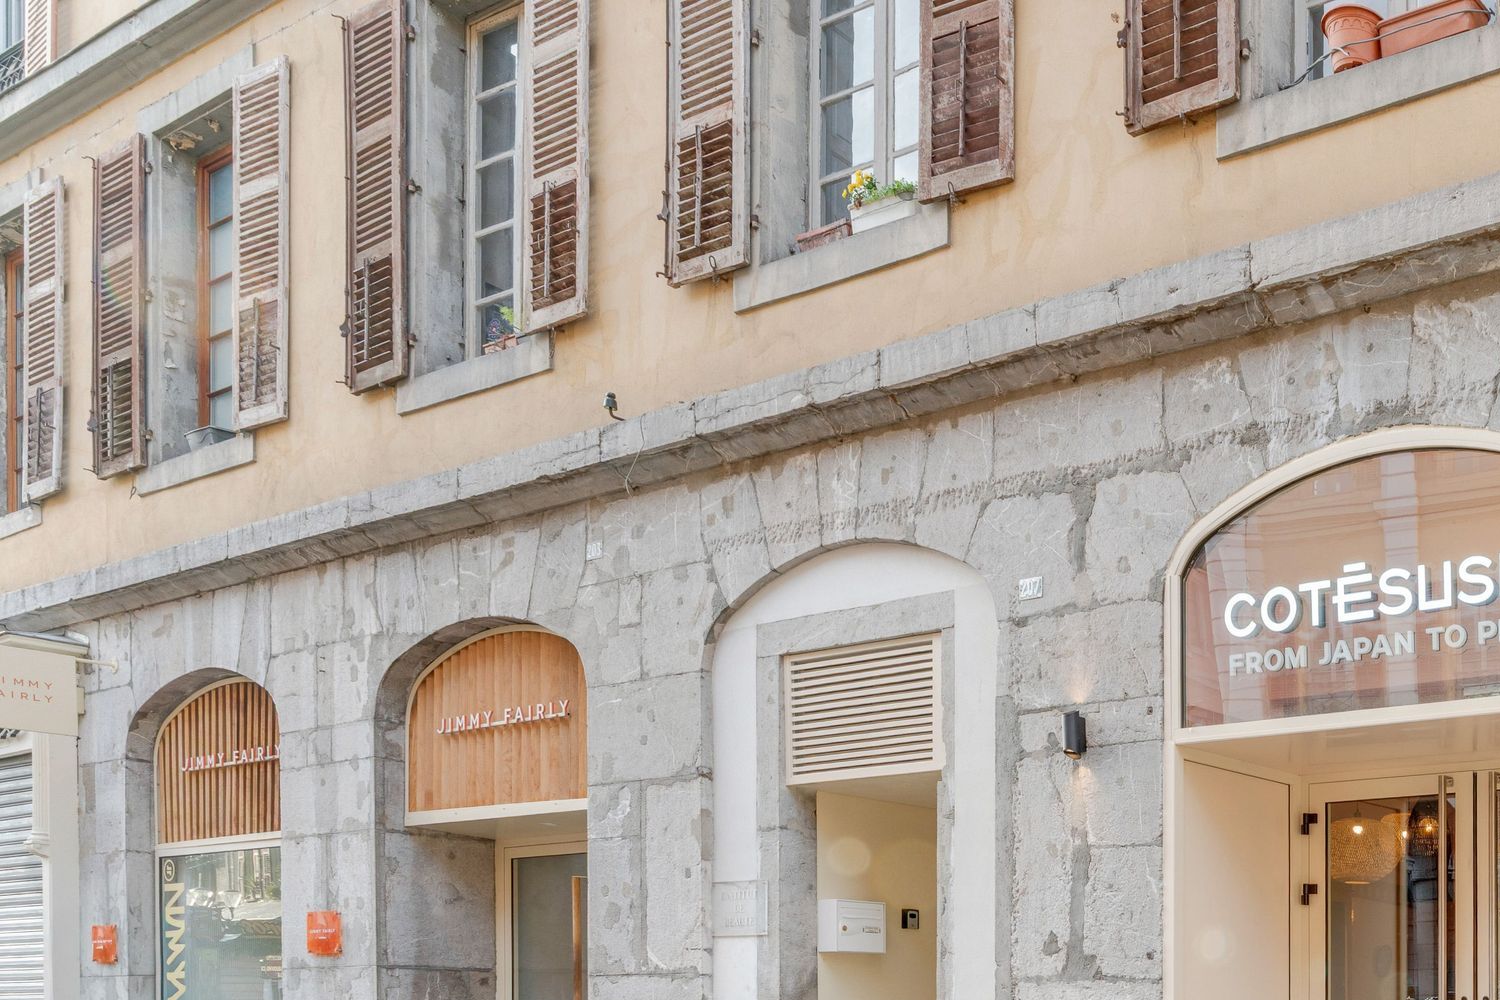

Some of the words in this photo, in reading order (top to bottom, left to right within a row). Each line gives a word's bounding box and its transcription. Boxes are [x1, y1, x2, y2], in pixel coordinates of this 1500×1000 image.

[1228, 644, 1309, 677] FROM
[1318, 630, 1416, 667] JAPAN
[1425, 623, 1468, 652] TO
[1, 676, 53, 690] IMMY
[436, 710, 493, 734] JIMMY
[503, 700, 569, 724] FAIRLY
[181, 752, 224, 772] JIMMY
[232, 744, 280, 764] FAIRLY
